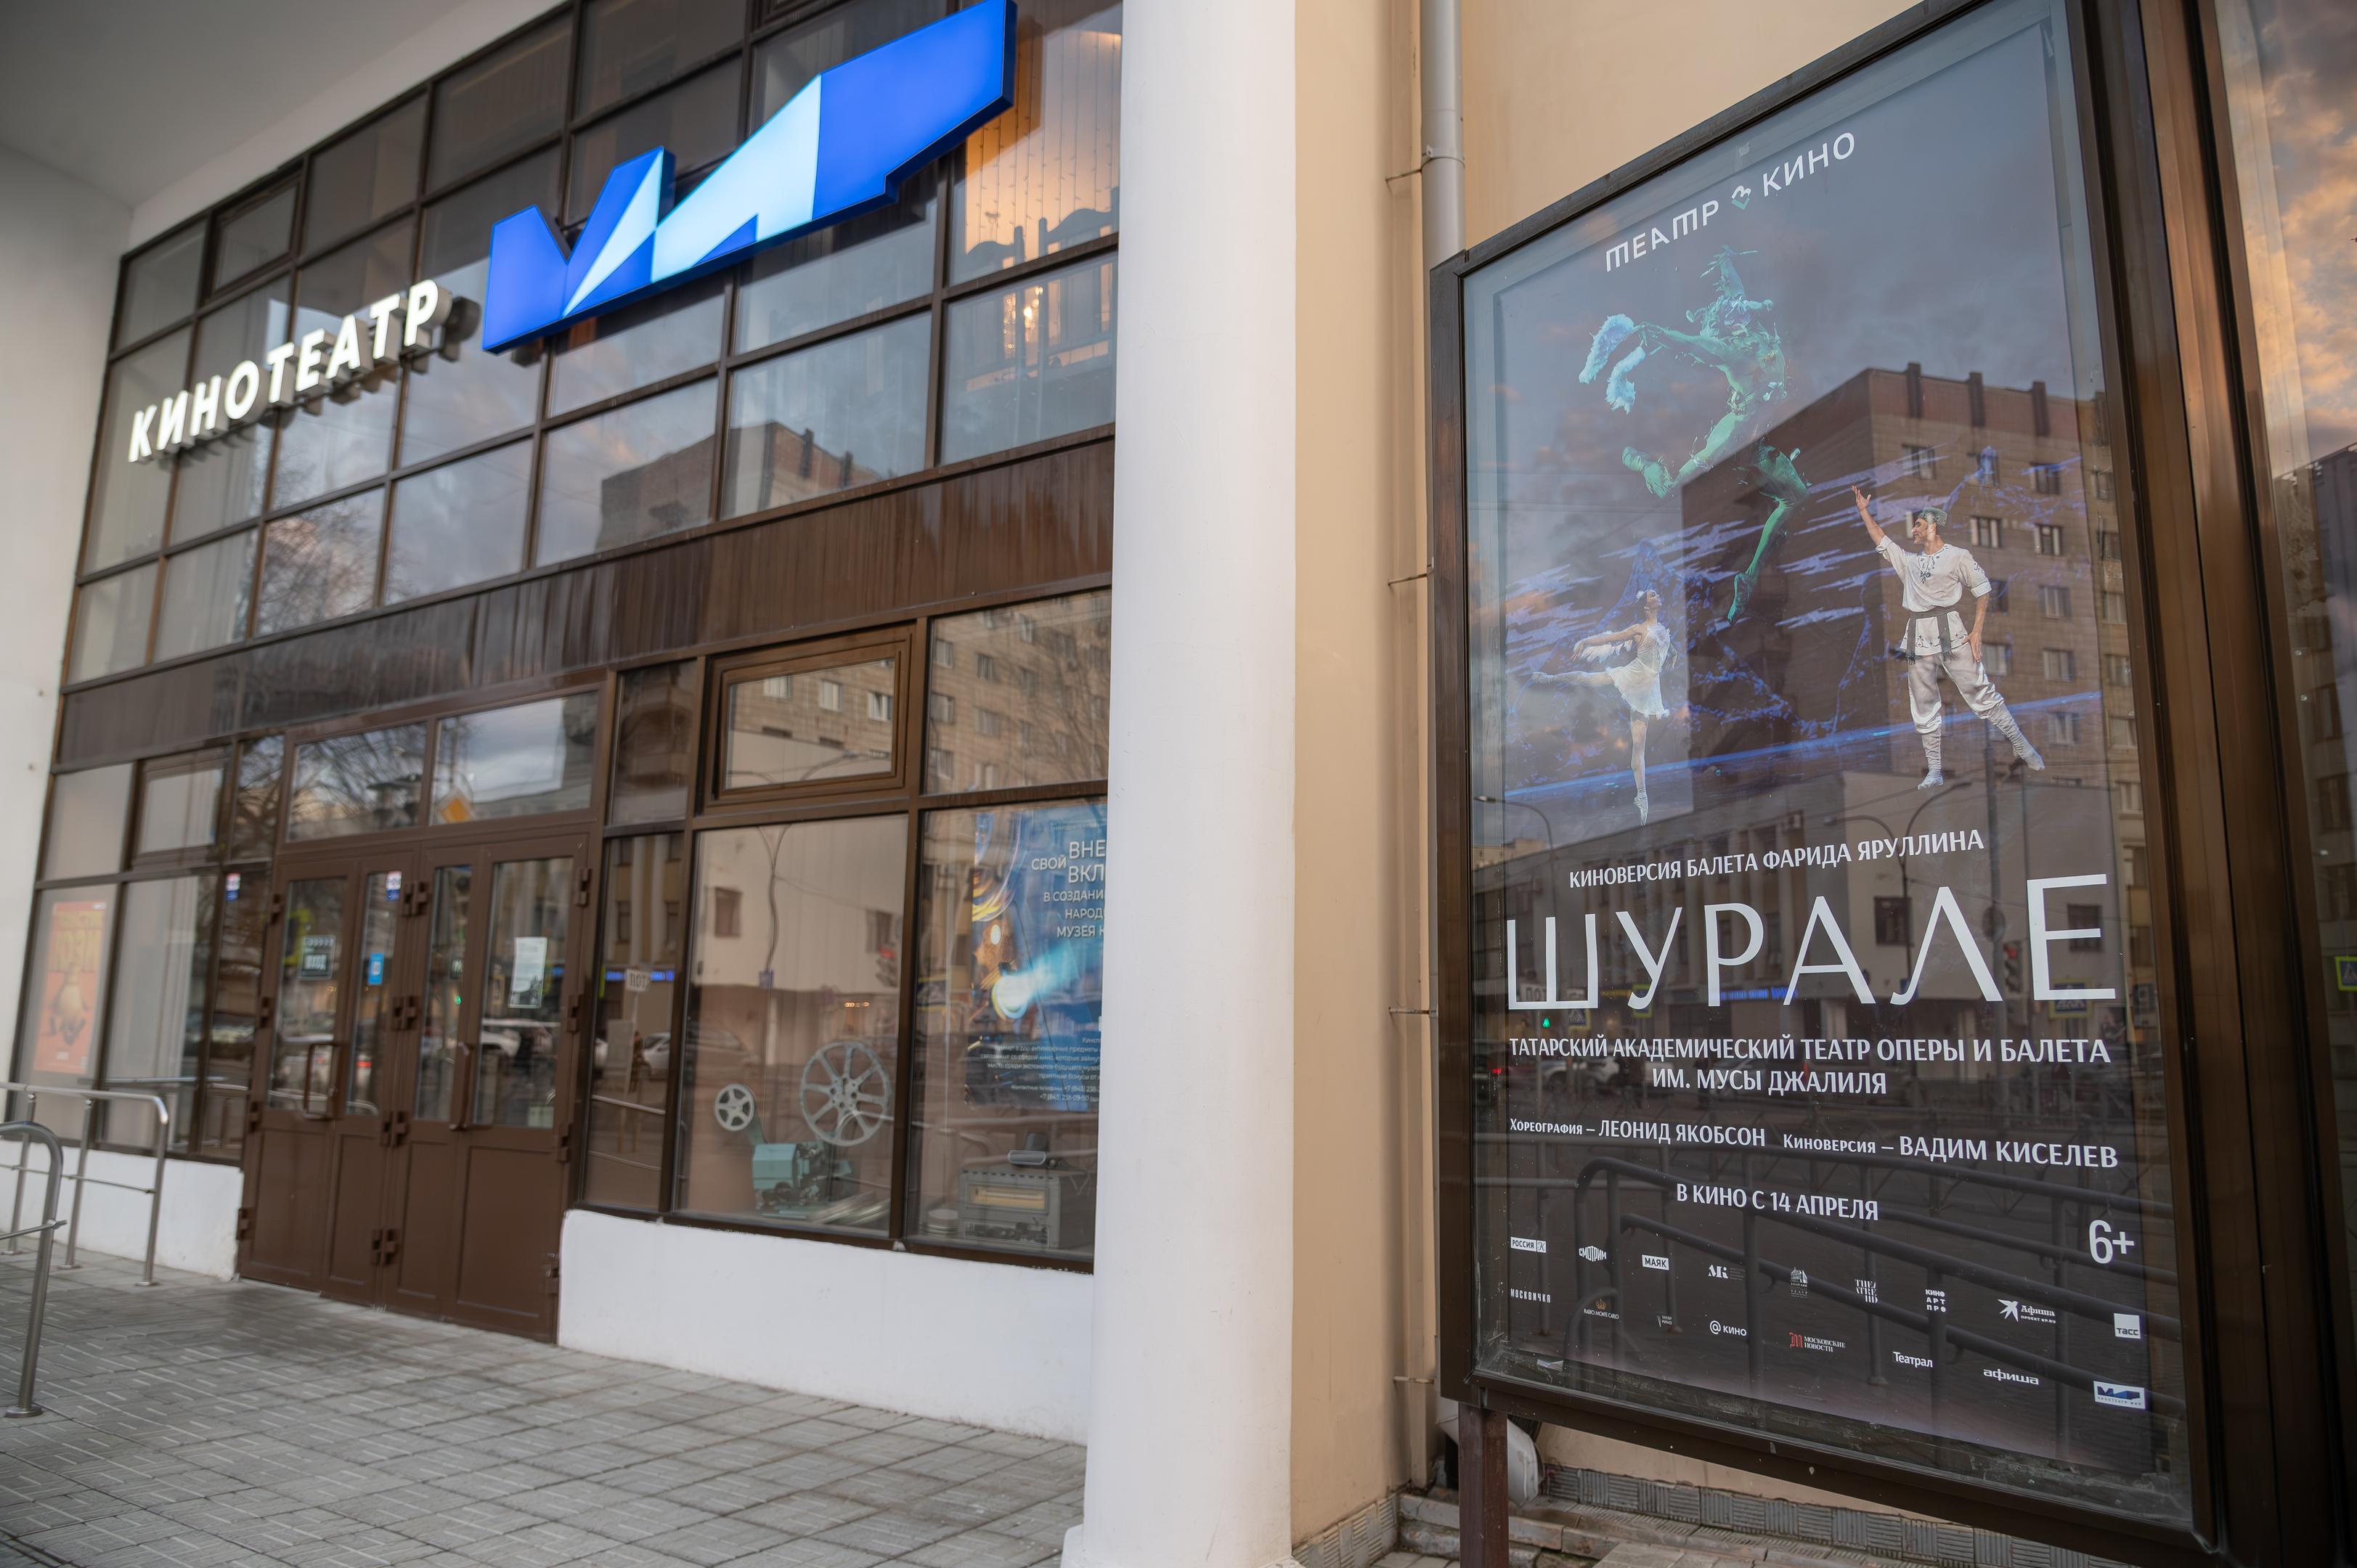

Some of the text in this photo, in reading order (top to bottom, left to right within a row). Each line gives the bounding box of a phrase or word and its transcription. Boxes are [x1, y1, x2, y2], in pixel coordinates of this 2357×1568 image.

[1762, 132, 1855, 197] КИНО
[129, 279, 440, 462] КИНОТЕАТР
[1070, 839, 1106, 859] ВНЕ
[1031, 854, 1067, 870] СВОЙ
[1570, 829, 1984, 889] КИНОВЕРСИЯ БАЛЕТА ФАРИДА ЯРУЛЛИНА
[1068, 864, 1104, 883] ВКЛ
[1043, 889, 1104, 902] В СОЗДАНИ
[1065, 907, 1104, 920] НАРОД
[1057, 925, 1096, 938] МУЗЕЯ
[1507, 873, 2116, 1010] ШУРАЛЕ
[1509, 1034, 2111, 1063] ТАТАРСКИЙ АКАДЕМИЧЕСКИЙ ТЕАТР ОПЕРЫ И БАЛЕТА
[1653, 1068, 1886, 1096] ИМ. МУСЫ ДЖАЛИЛЯ
[1598, 1119, 1671, 1145] ЛЕОНИД
[1676, 1124, 1765, 1147] ЯКОБСОН
[1900, 1135, 1987, 1163] ВАДИМ
[1995, 1140, 2118, 1168] КИСЕЛЕВ
[1677, 1183, 1878, 1221] В КИНО С 14 АПРЕЛЯ
[1512, 1239, 1534, 1249] РОССИЯ
[2089, 1220, 2135, 1264] 6+
[1579, 1246, 1607, 1262] СМОТРИМ
[1645, 1257, 1667, 1267] МАЯК
[1510, 1289, 1551, 1303] МОСКВИЧКА
[2021, 1305, 2056, 1317] Афиша
[1723, 1325, 1747, 1336] КИНО
[1804, 1336, 1846, 1348] МОСКОВСКИЕ
[1804, 1342, 1833, 1352] НОВОСТИ
[1893, 1351, 1933, 1368] Театрал
[1983, 1368, 2039, 1385] афиша
